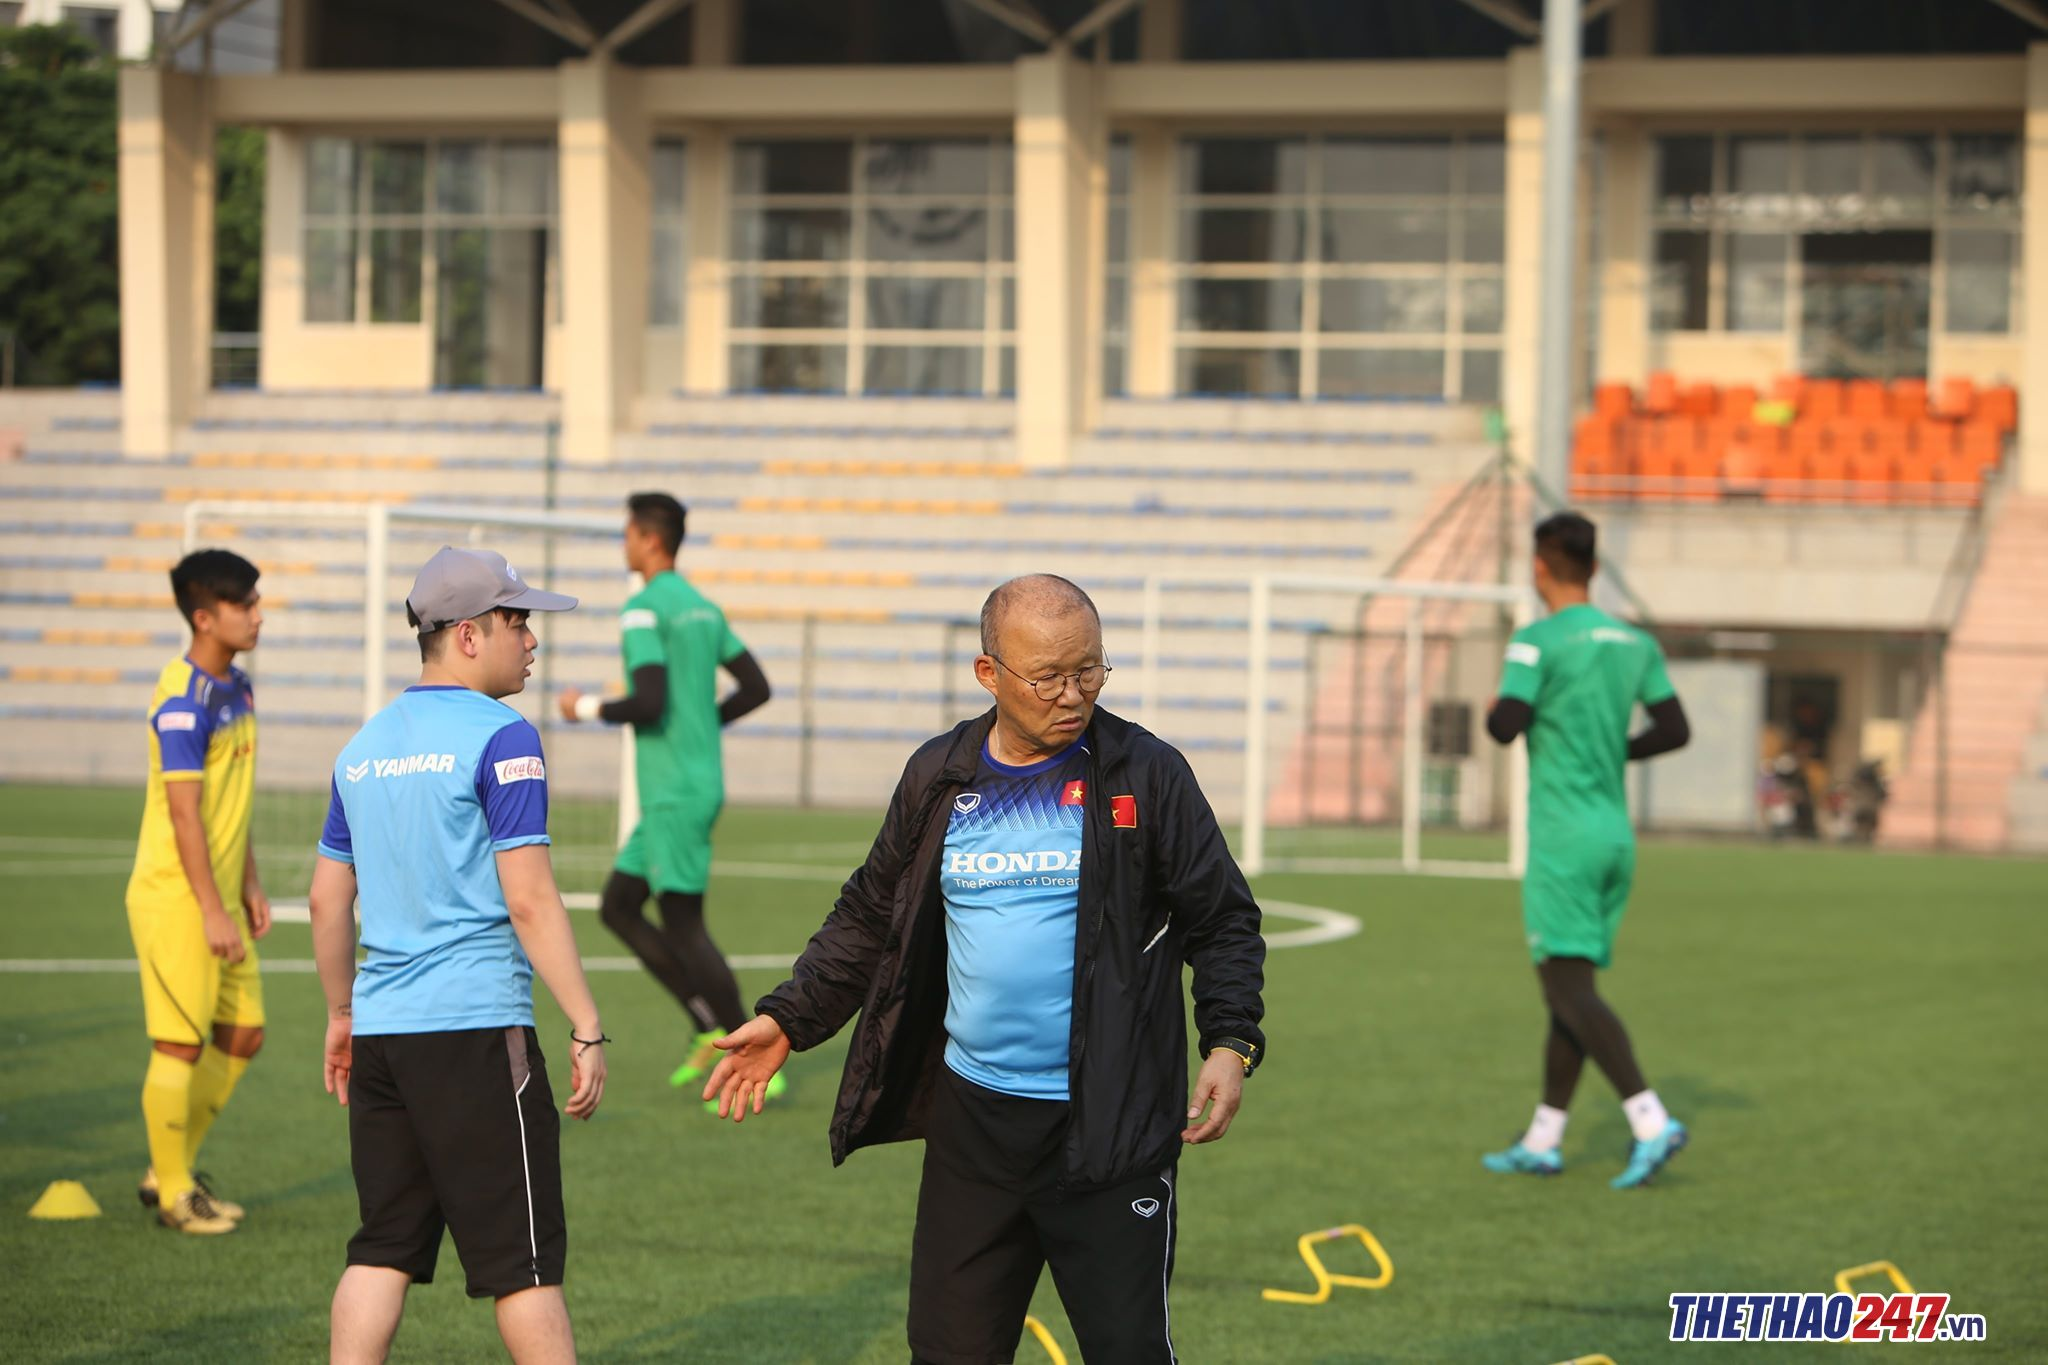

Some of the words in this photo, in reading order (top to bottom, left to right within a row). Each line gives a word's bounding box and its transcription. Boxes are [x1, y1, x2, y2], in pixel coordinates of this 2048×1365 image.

[373, 753, 455, 778] YANMAR
[954, 878, 977, 889] The
[978, 878, 1021, 889] Power
[1023, 876, 1038, 886] of
